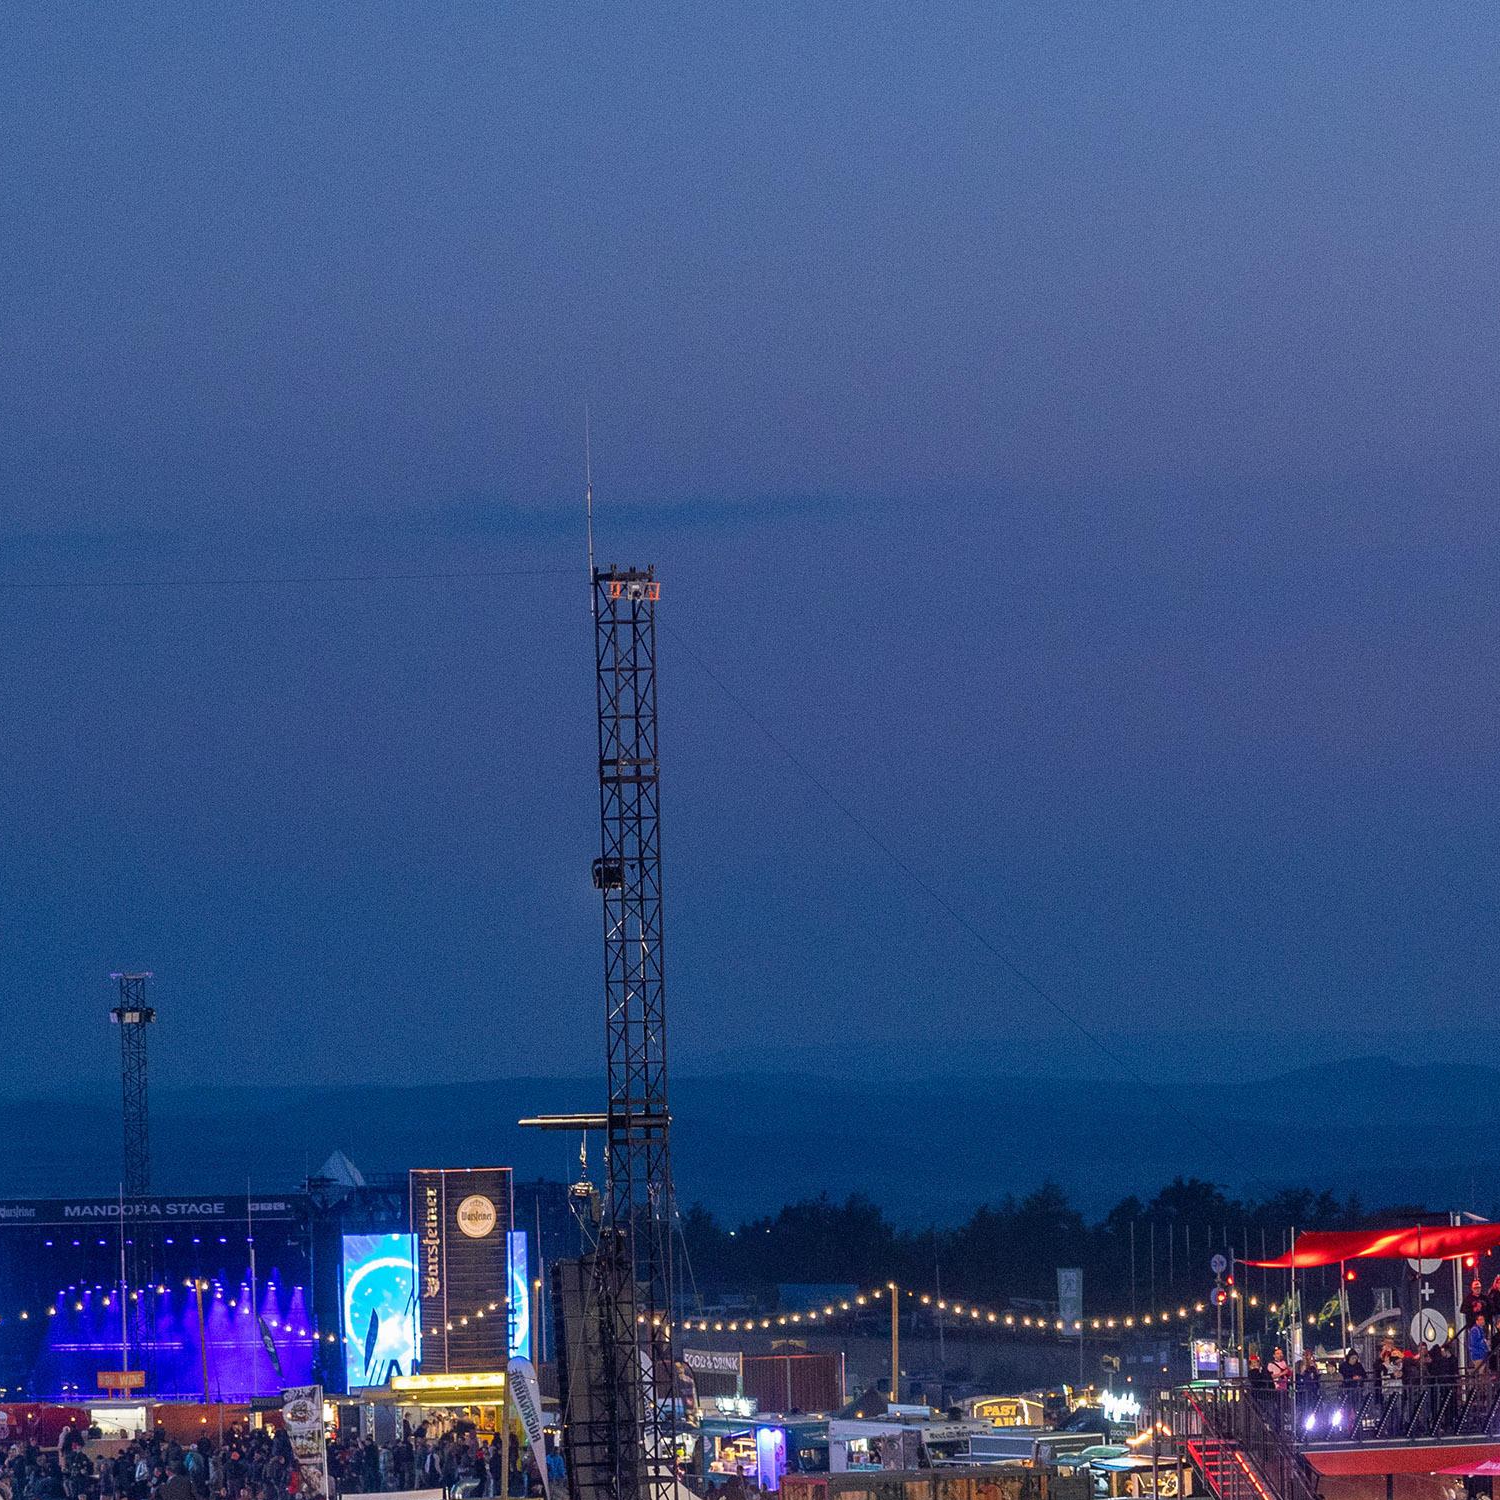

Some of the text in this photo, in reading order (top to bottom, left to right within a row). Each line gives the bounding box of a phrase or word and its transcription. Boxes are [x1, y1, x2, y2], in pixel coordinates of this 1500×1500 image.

[64, 1202, 225, 1217] MANDORA STAGE
[422, 1186, 440, 1298] Warsteiner
[684, 1353, 706, 1368] FOOD
[714, 1356, 739, 1370] DRINK
